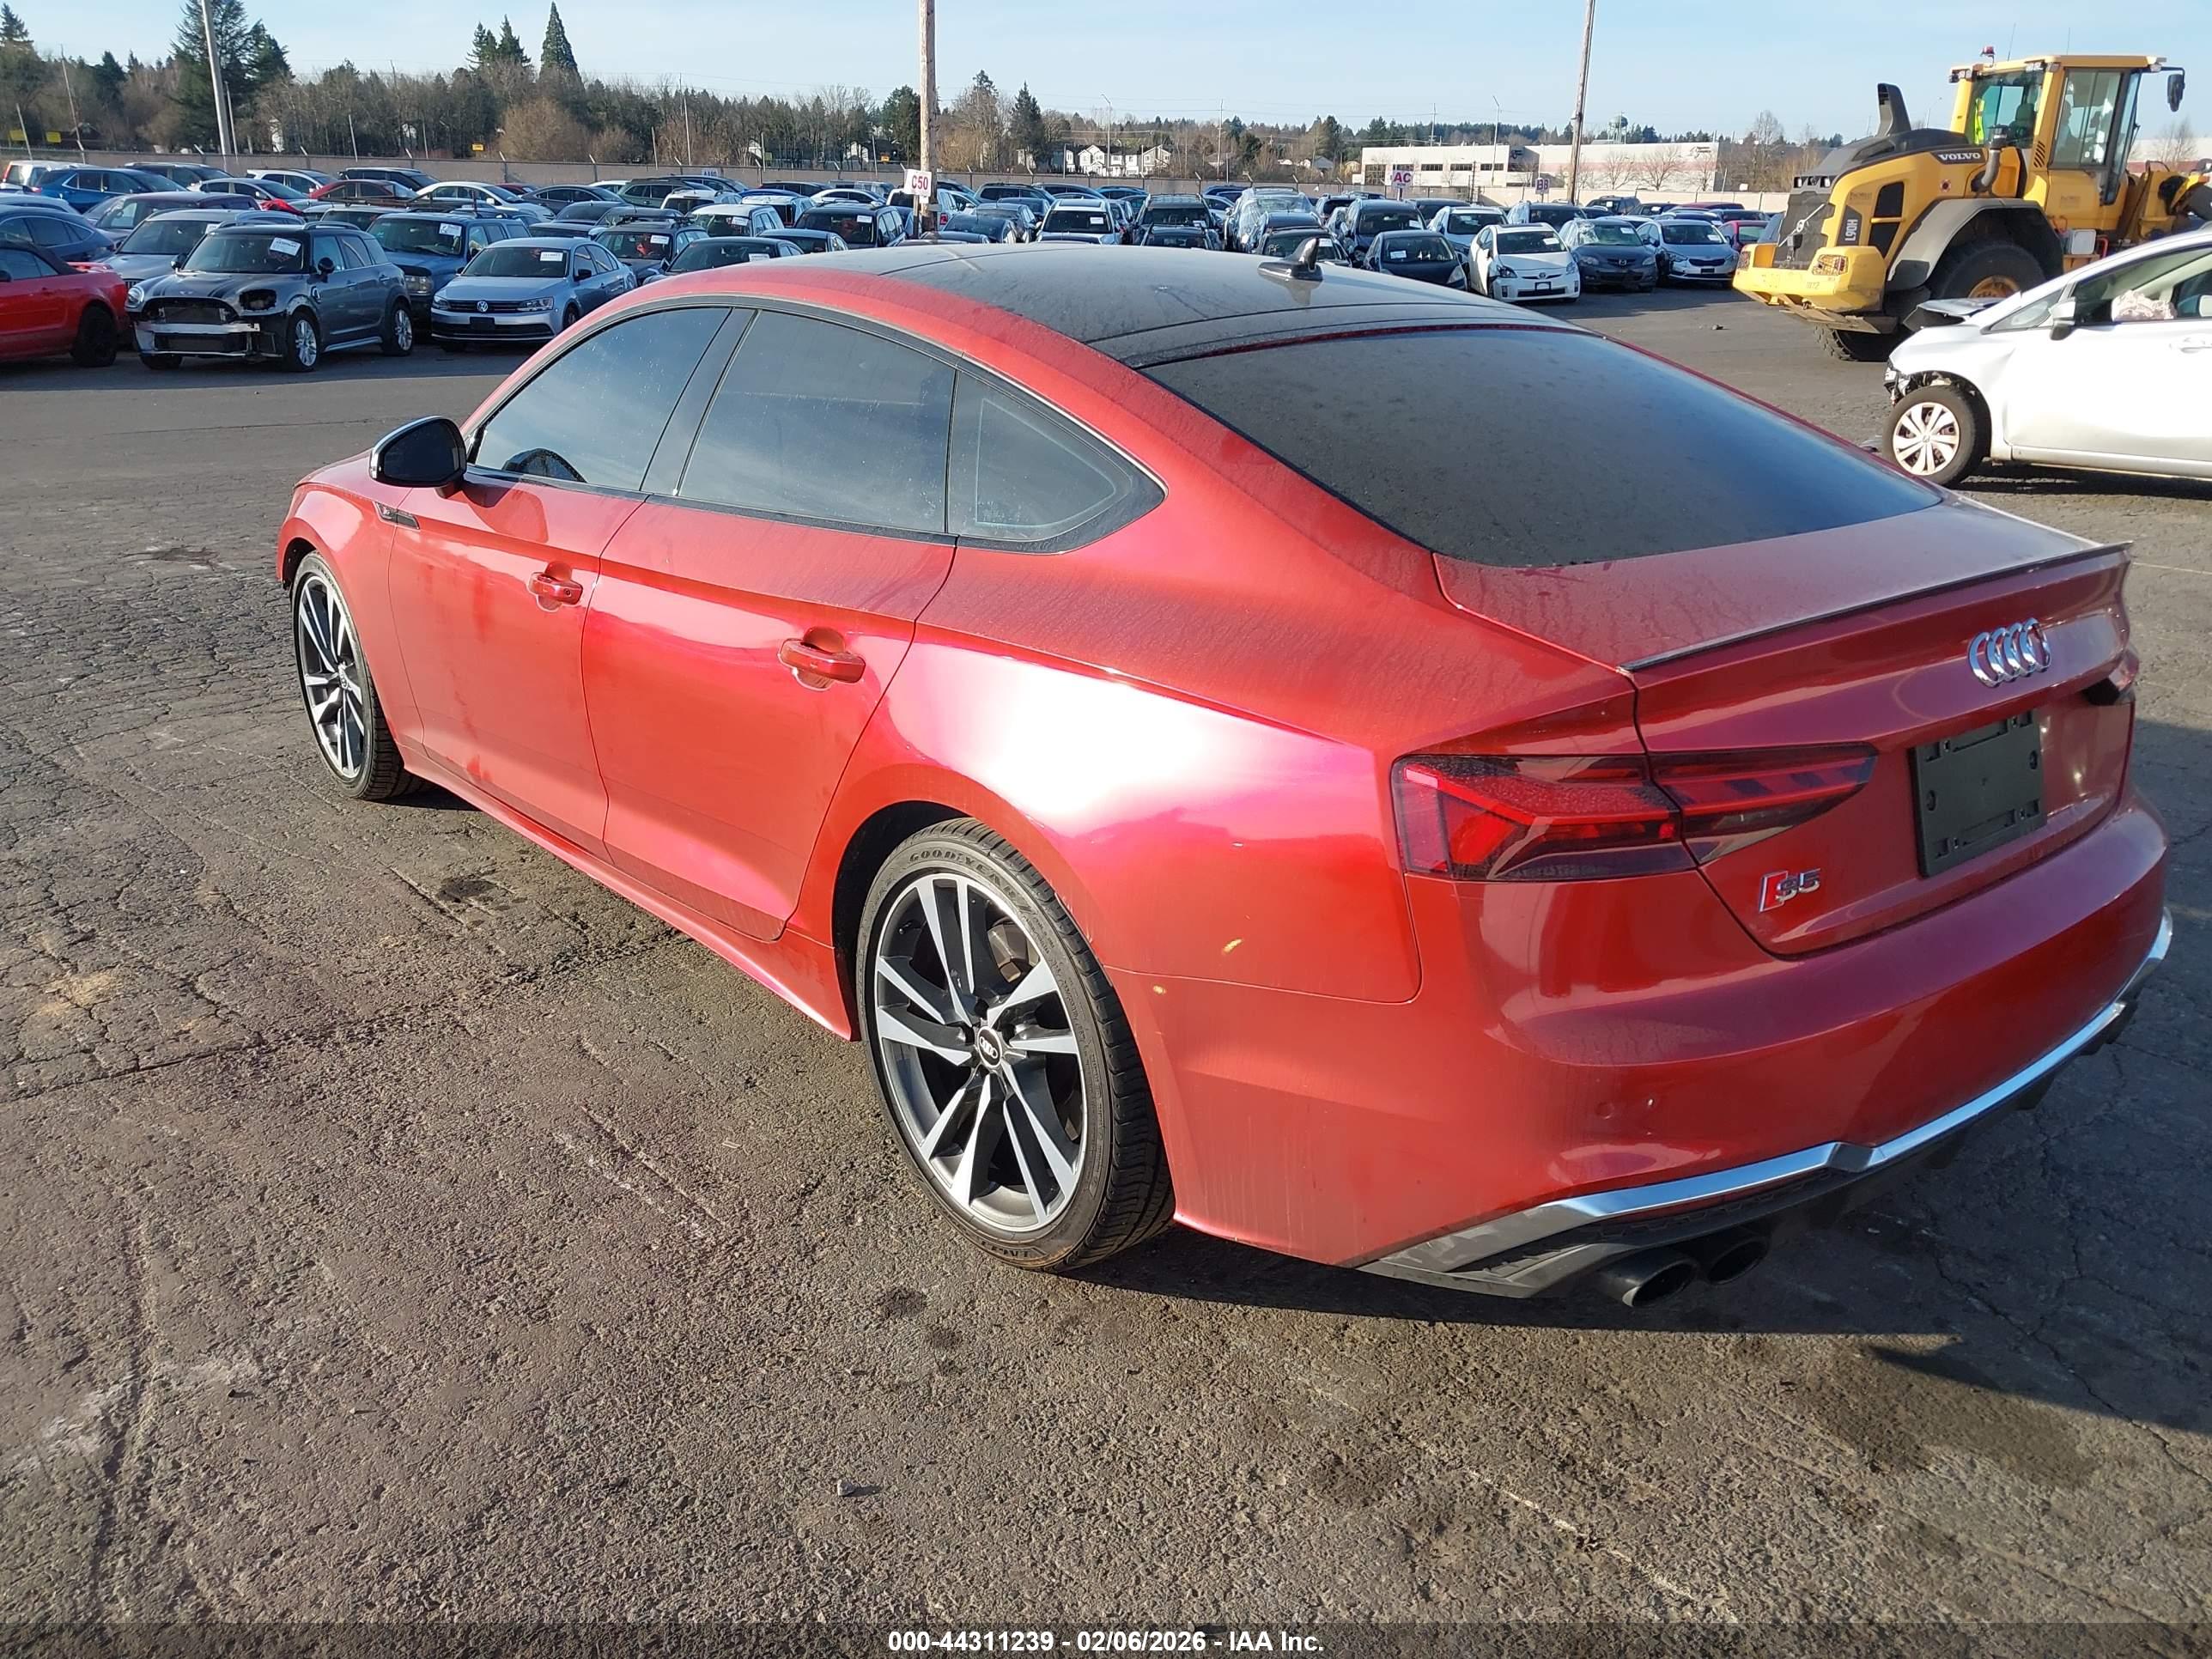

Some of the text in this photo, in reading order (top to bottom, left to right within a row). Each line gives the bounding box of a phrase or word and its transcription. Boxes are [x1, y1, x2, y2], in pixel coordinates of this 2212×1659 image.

[1937, 152, 1981, 161] VOLVO
[911, 175, 929, 191] C50
[1393, 172, 1412, 183] AC
[909, 849, 1018, 899] GOODYEAR
[1772, 867, 1821, 902] S5
